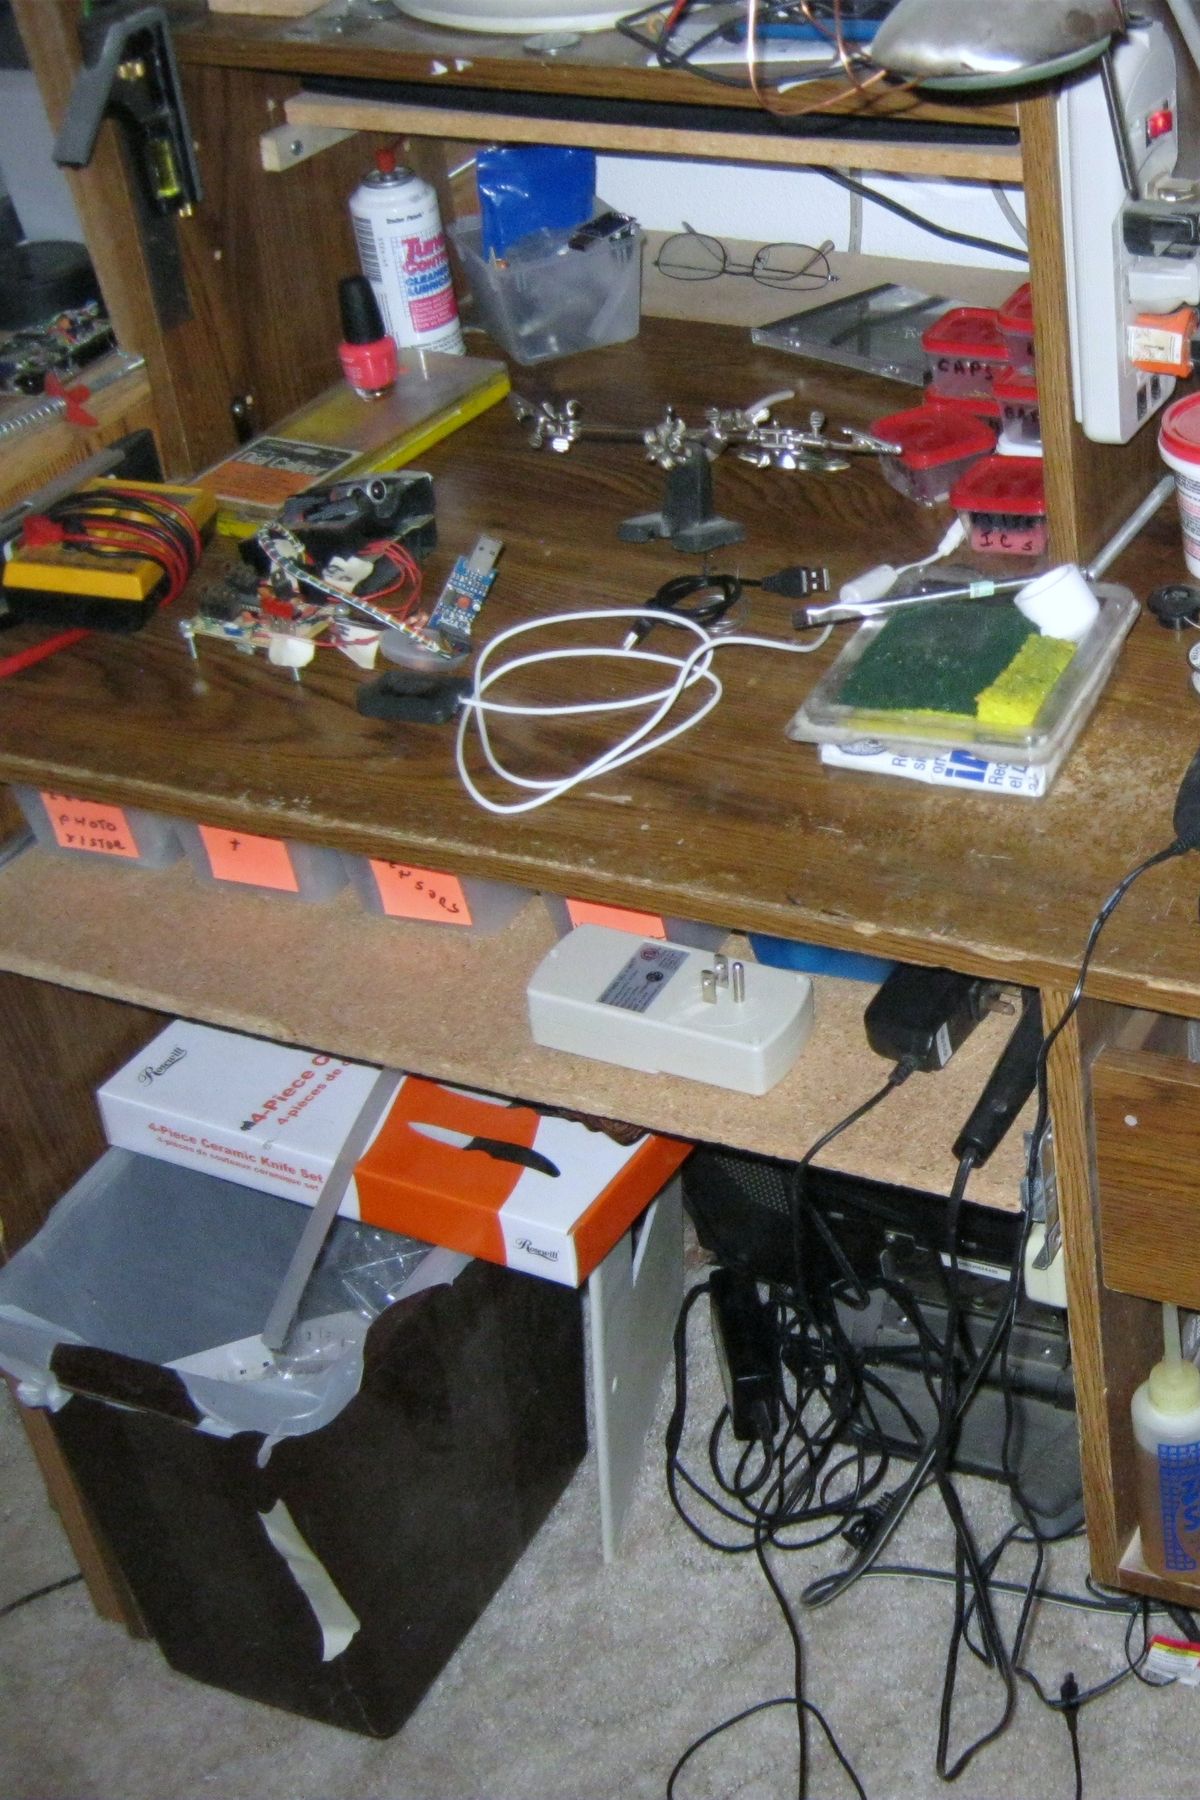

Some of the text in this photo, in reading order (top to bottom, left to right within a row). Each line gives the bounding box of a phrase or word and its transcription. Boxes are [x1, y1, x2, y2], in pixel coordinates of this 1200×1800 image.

[58, 813, 117, 833] PHOTO
[137, 1046, 188, 1088] Rosewill
[251, 1069, 316, 1126] 4-Piece
[148, 1121, 324, 1184] 4-Piece Ceramic Knife Set
[513, 1238, 560, 1262] Rosewill
